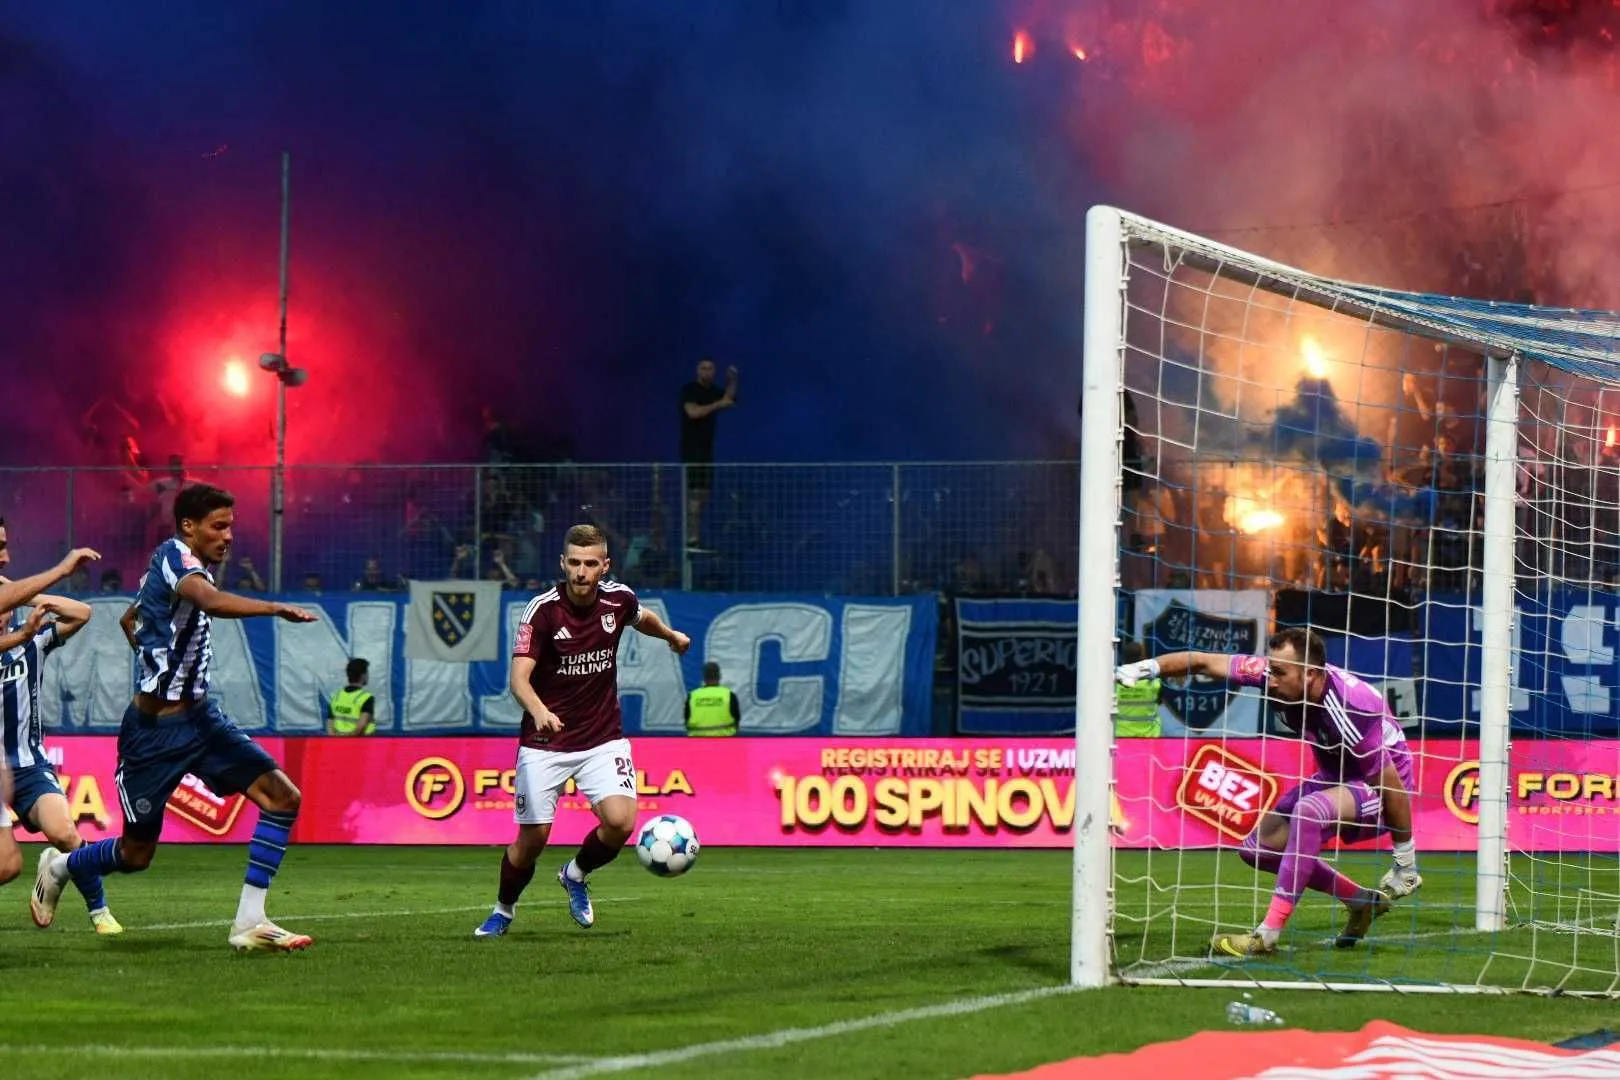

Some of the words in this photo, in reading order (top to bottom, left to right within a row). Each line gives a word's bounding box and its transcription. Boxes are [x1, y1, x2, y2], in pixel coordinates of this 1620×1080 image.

[560, 646, 614, 665] TURKISH
[1009, 671, 1058, 693] 1921
[1174, 696, 1218, 711] 1921
[821, 748, 969, 769] REGISTRIRAJ
[975, 748, 1001, 769] SE
[1006, 748, 1014, 769] I
[1198, 760, 1260, 810] BEZ
[1518, 773, 1620, 799] FOR
[780, 775, 868, 828] 100
